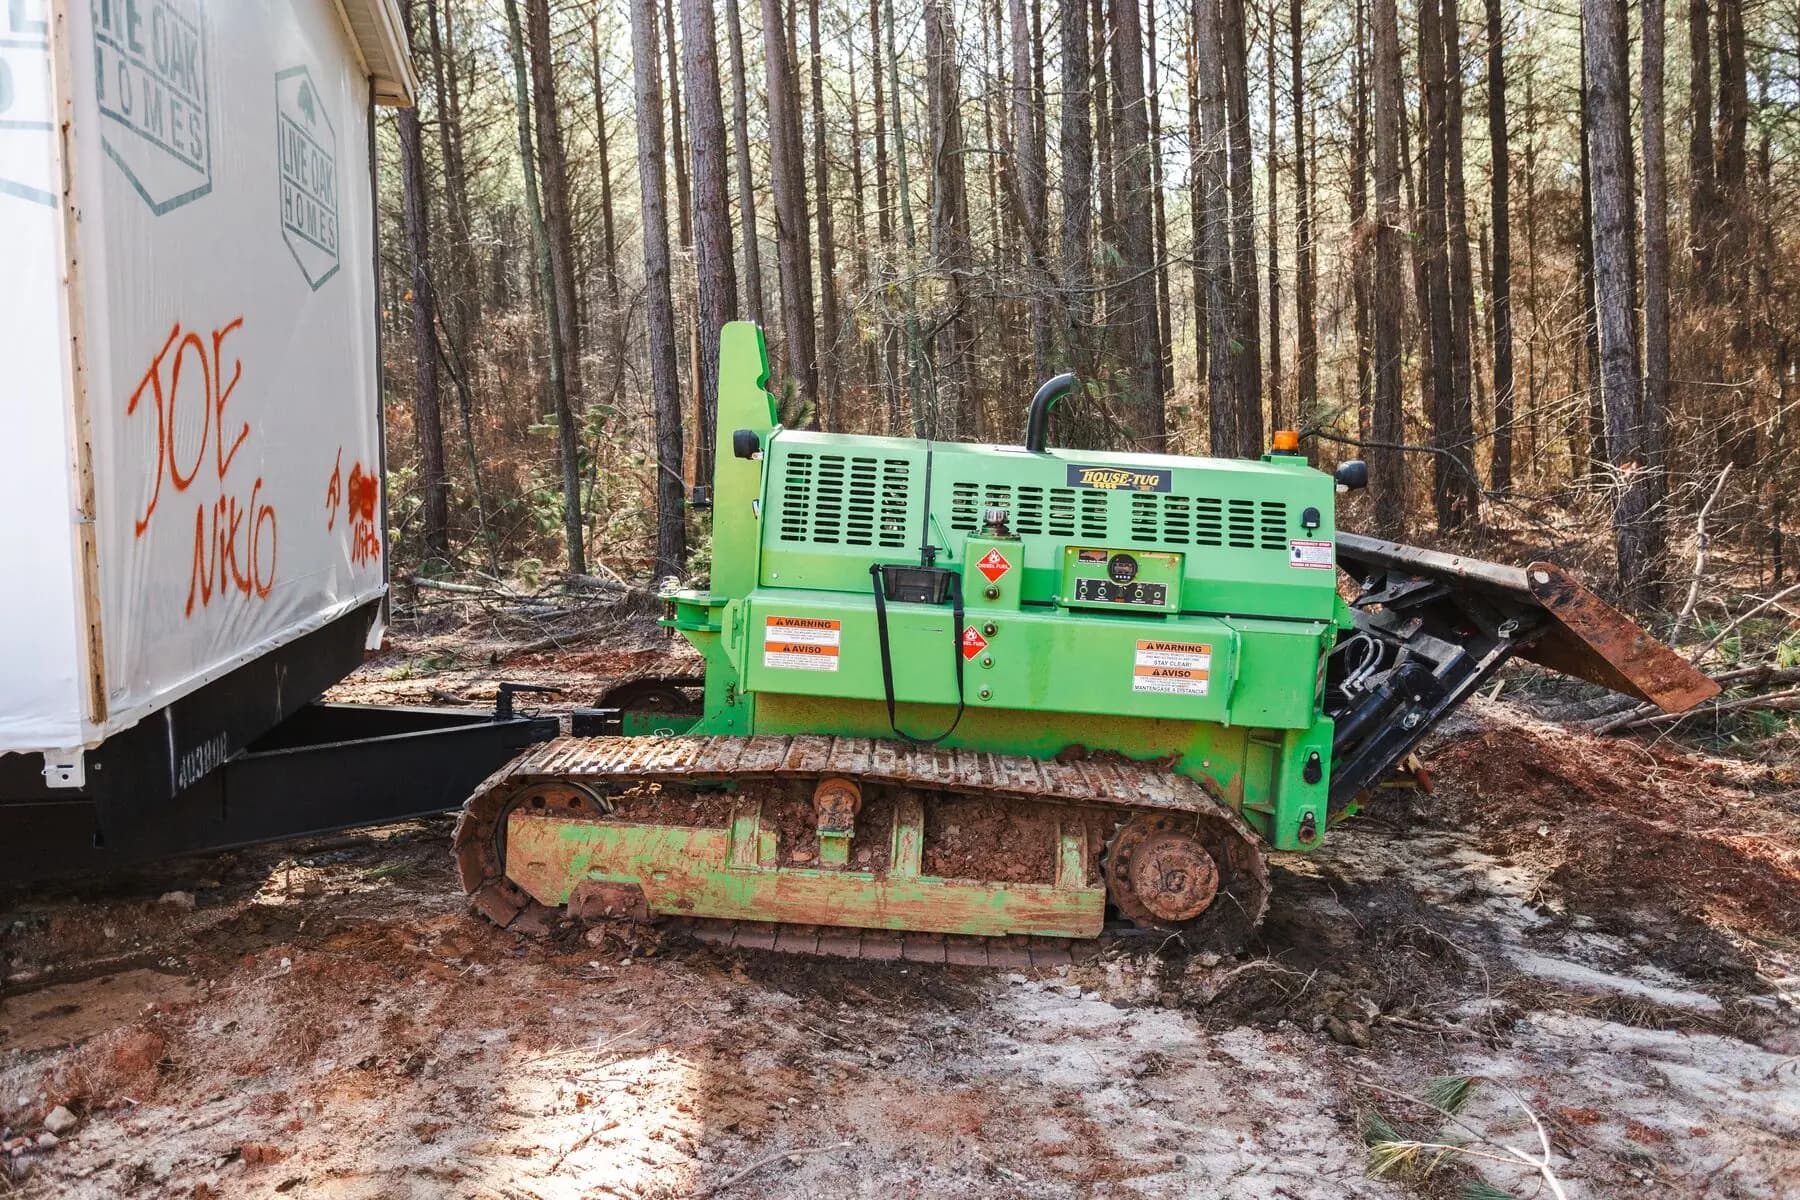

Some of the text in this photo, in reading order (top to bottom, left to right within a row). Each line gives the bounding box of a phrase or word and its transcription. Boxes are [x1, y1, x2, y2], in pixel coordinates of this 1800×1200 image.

[152, 6, 200, 101] OAK
[282, 121, 335, 206] LIVE OAK
[284, 183, 335, 249] HOMES
[127, 316, 249, 539] JOE
[1082, 471, 1160, 486] HOUSE-TUG
[785, 618, 831, 628] WARNING
[792, 646, 822, 654] AVISO
[1155, 643, 1202, 653] WARNING
[1161, 669, 1192, 678] AVISO
